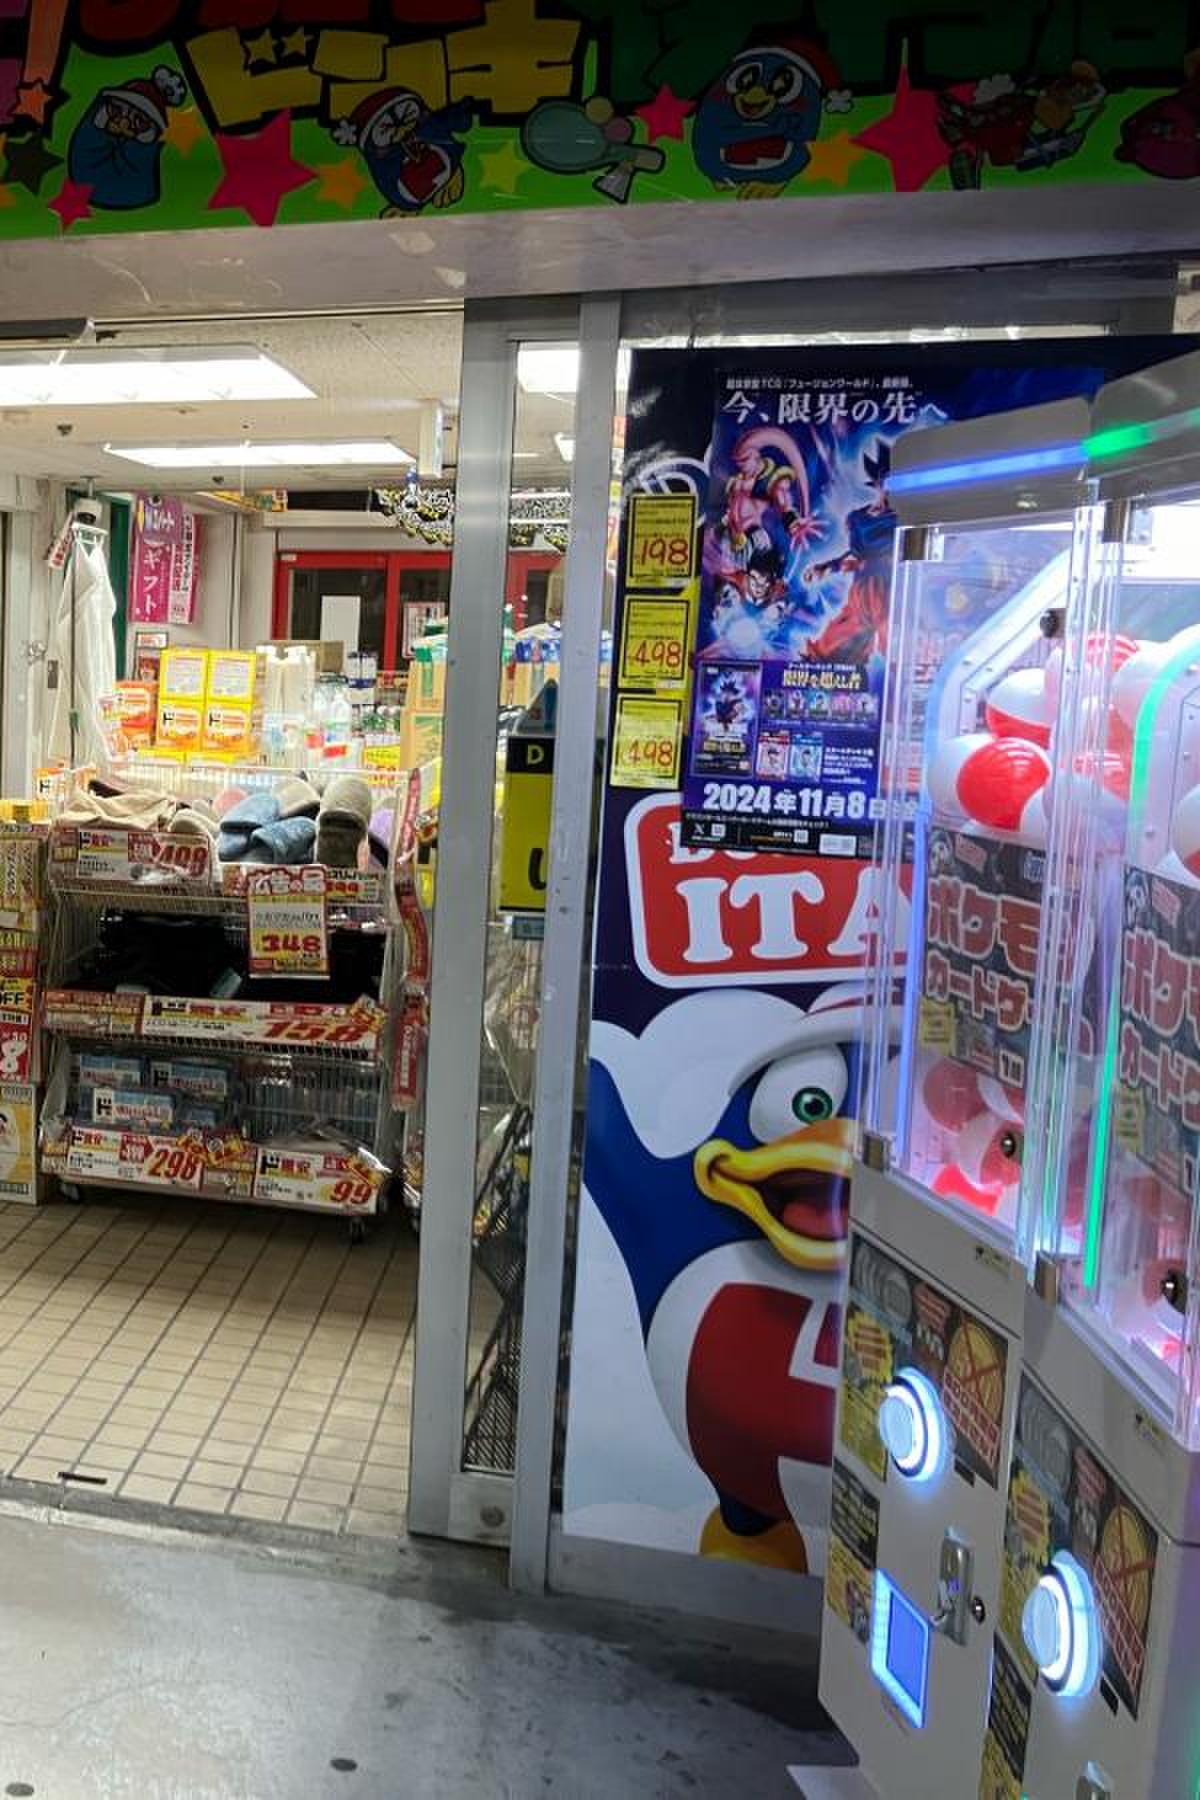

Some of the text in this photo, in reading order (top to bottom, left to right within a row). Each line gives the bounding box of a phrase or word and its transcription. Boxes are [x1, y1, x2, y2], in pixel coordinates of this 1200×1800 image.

[722, 390, 949, 425] 今、限界の先へ
[635, 640, 682, 669] 498
[627, 739, 673, 768] 498
[329, 1180, 373, 1204] 99
